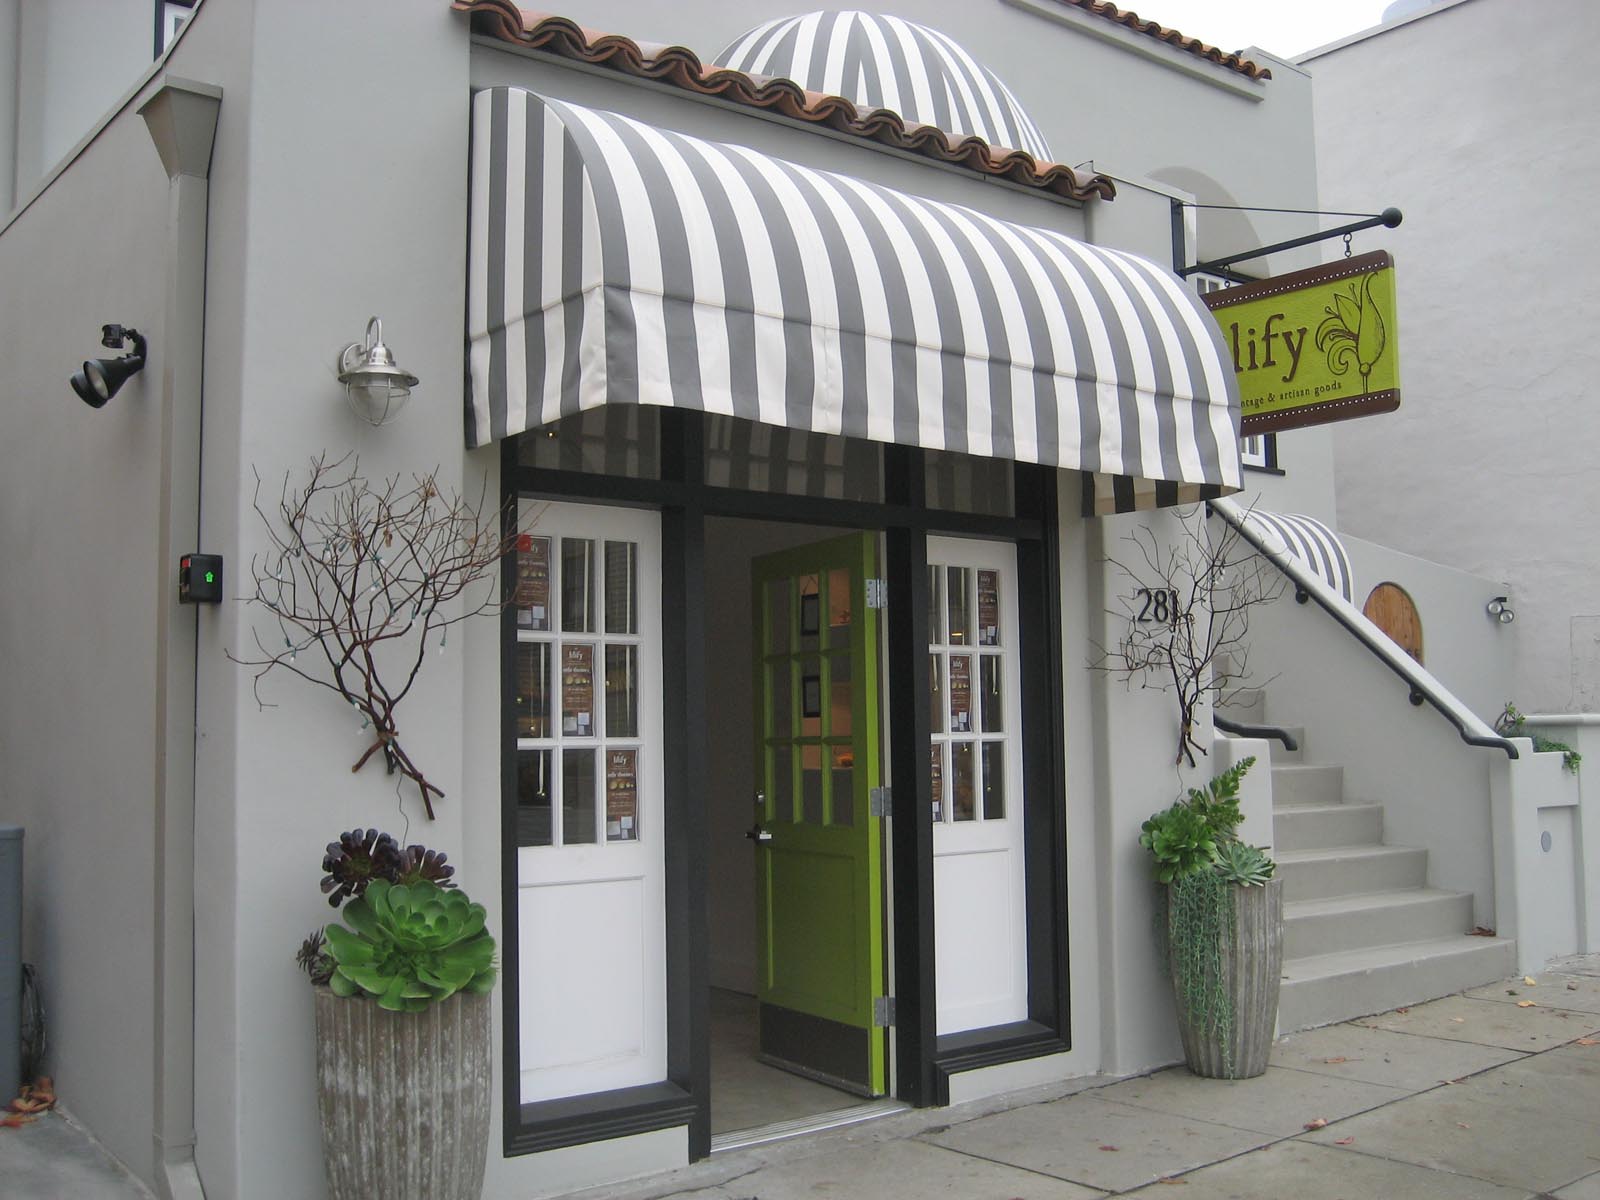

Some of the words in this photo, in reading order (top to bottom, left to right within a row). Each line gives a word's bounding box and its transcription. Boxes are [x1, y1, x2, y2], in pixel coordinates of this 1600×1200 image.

[1267, 392, 1276, 403] &
[1280, 387, 1310, 401] artisan
[1314, 380, 1342, 397] goods
